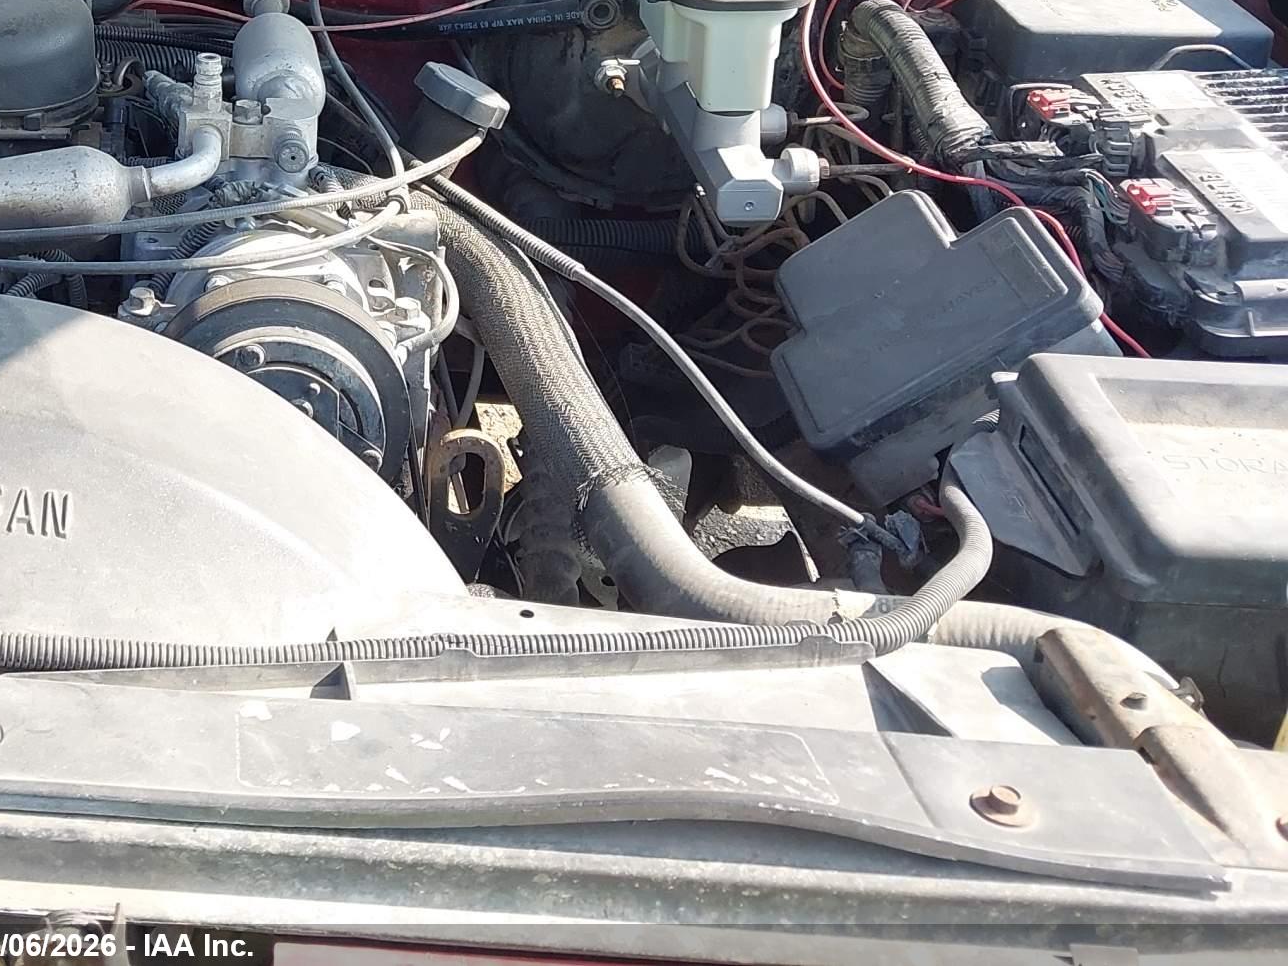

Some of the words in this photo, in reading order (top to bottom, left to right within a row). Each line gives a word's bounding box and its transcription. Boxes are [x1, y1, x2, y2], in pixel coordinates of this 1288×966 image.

[528, 14, 552, 25] CHINA
[554, 12, 563, 21] IN
[507, 17, 524, 27] MAX
